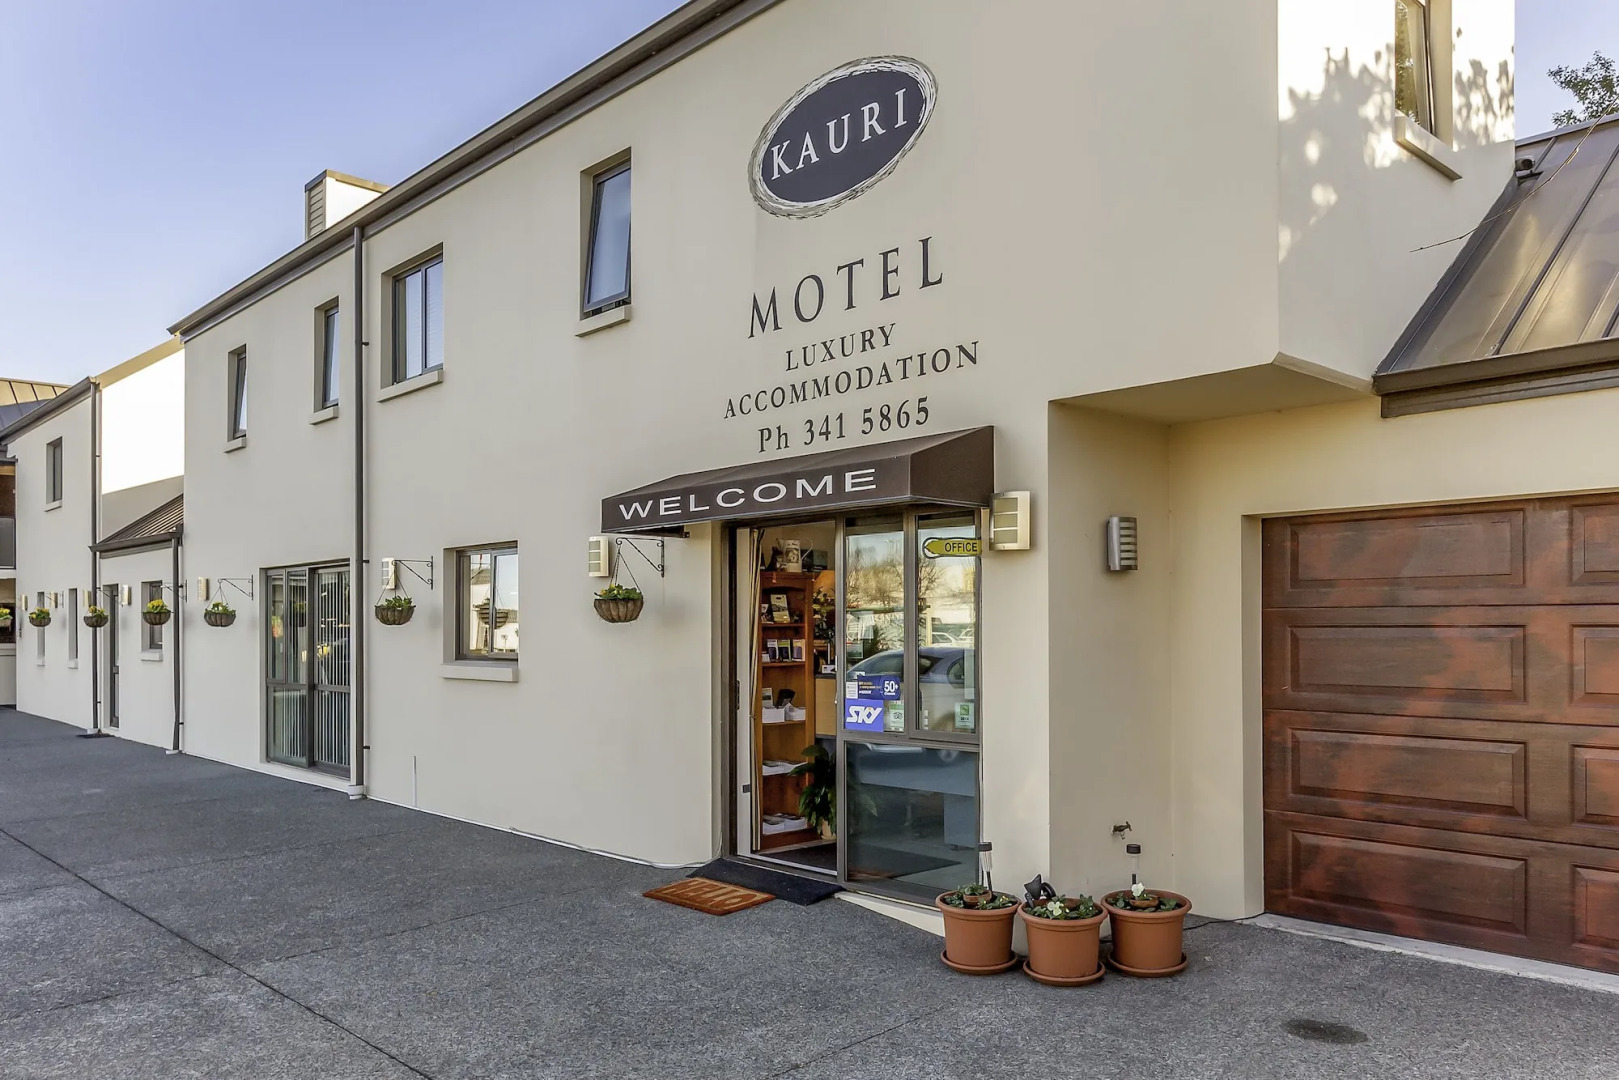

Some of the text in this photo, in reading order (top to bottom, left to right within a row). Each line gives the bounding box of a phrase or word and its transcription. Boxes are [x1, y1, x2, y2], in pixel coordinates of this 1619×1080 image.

[770, 88, 907, 180] KAURI
[748, 236, 943, 339] MOTEL
[785, 323, 896, 372] LUXURY
[723, 341, 979, 419] ACCOMMODATION
[758, 396, 929, 453] Ph 341 5865
[618, 468, 877, 520] WELCOME
[944, 542, 978, 553] OFFICE
[846, 705, 883, 724] SKY
